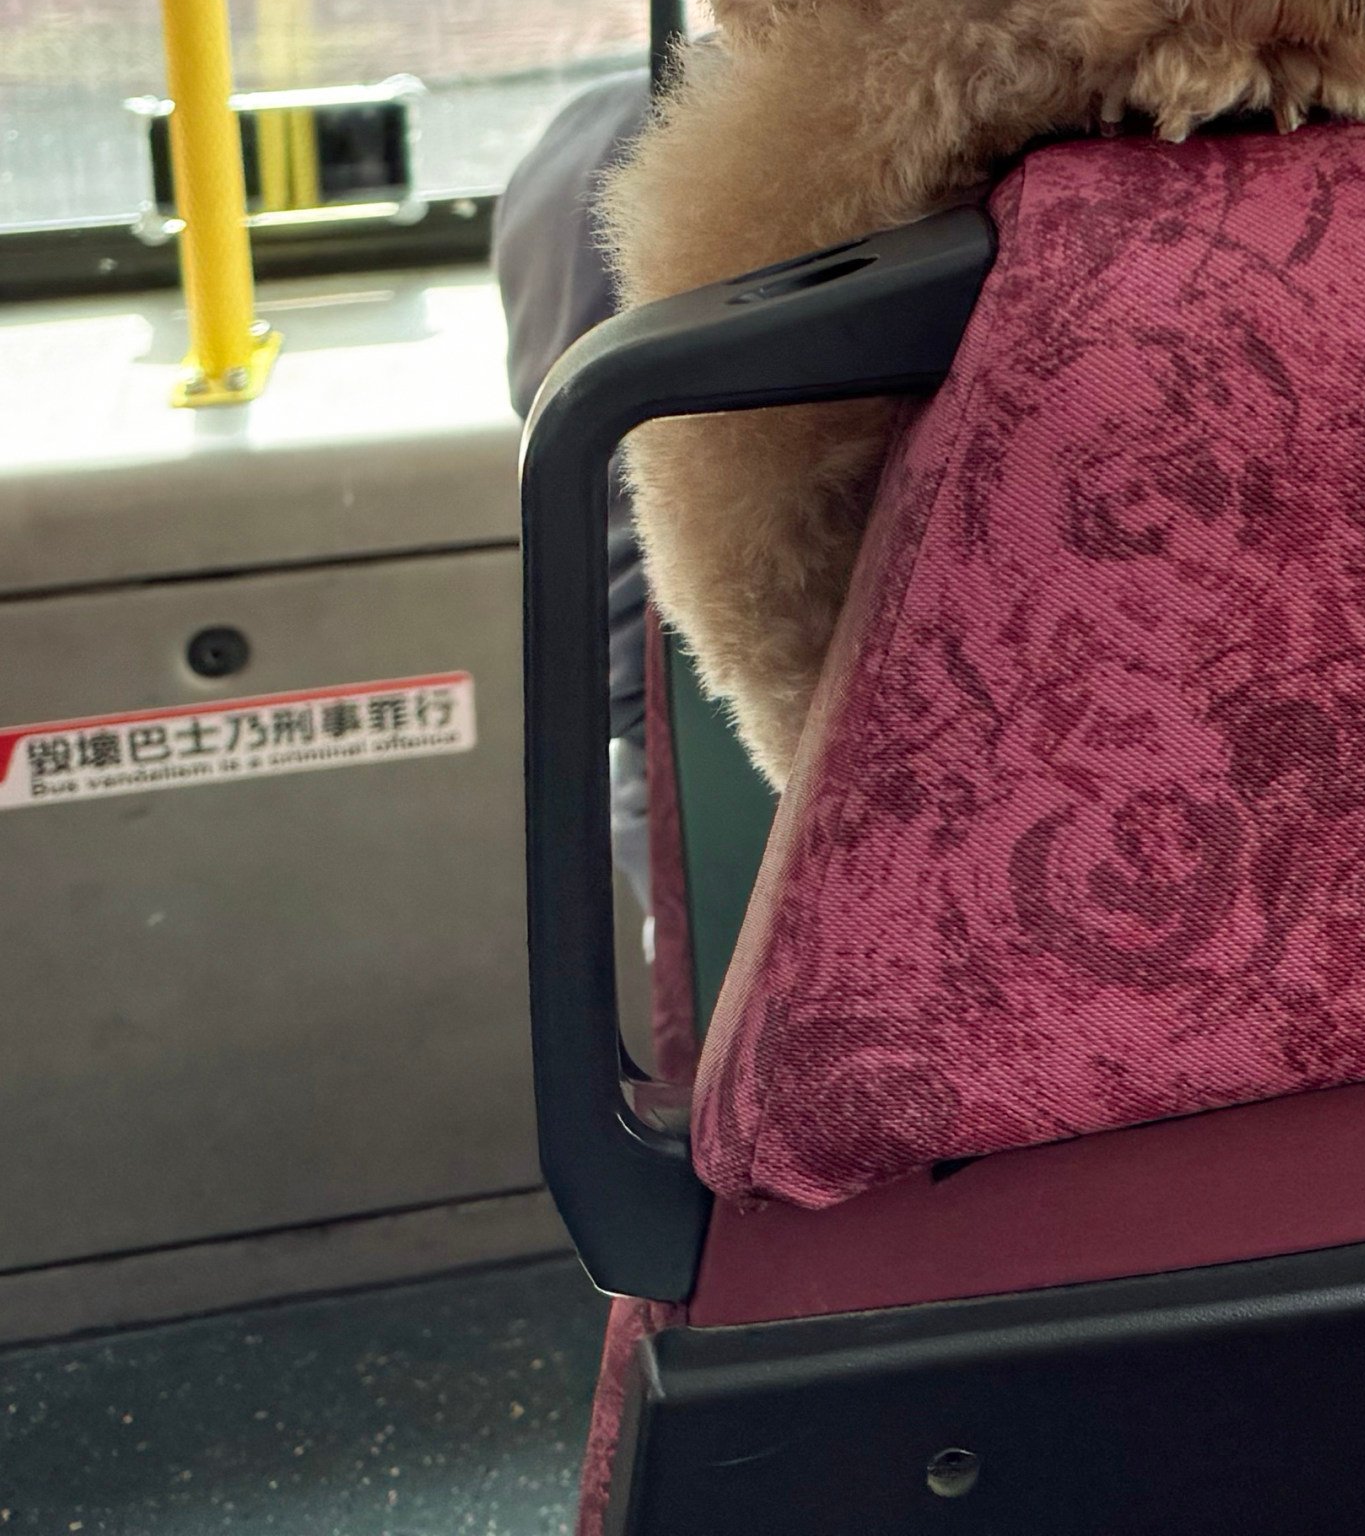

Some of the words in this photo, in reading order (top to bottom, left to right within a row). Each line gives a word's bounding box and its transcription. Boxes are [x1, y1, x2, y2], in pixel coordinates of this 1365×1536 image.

[28, 690, 453, 775] 毀壞巴士乃刑事罪行
[88, 761, 214, 789] vandalism
